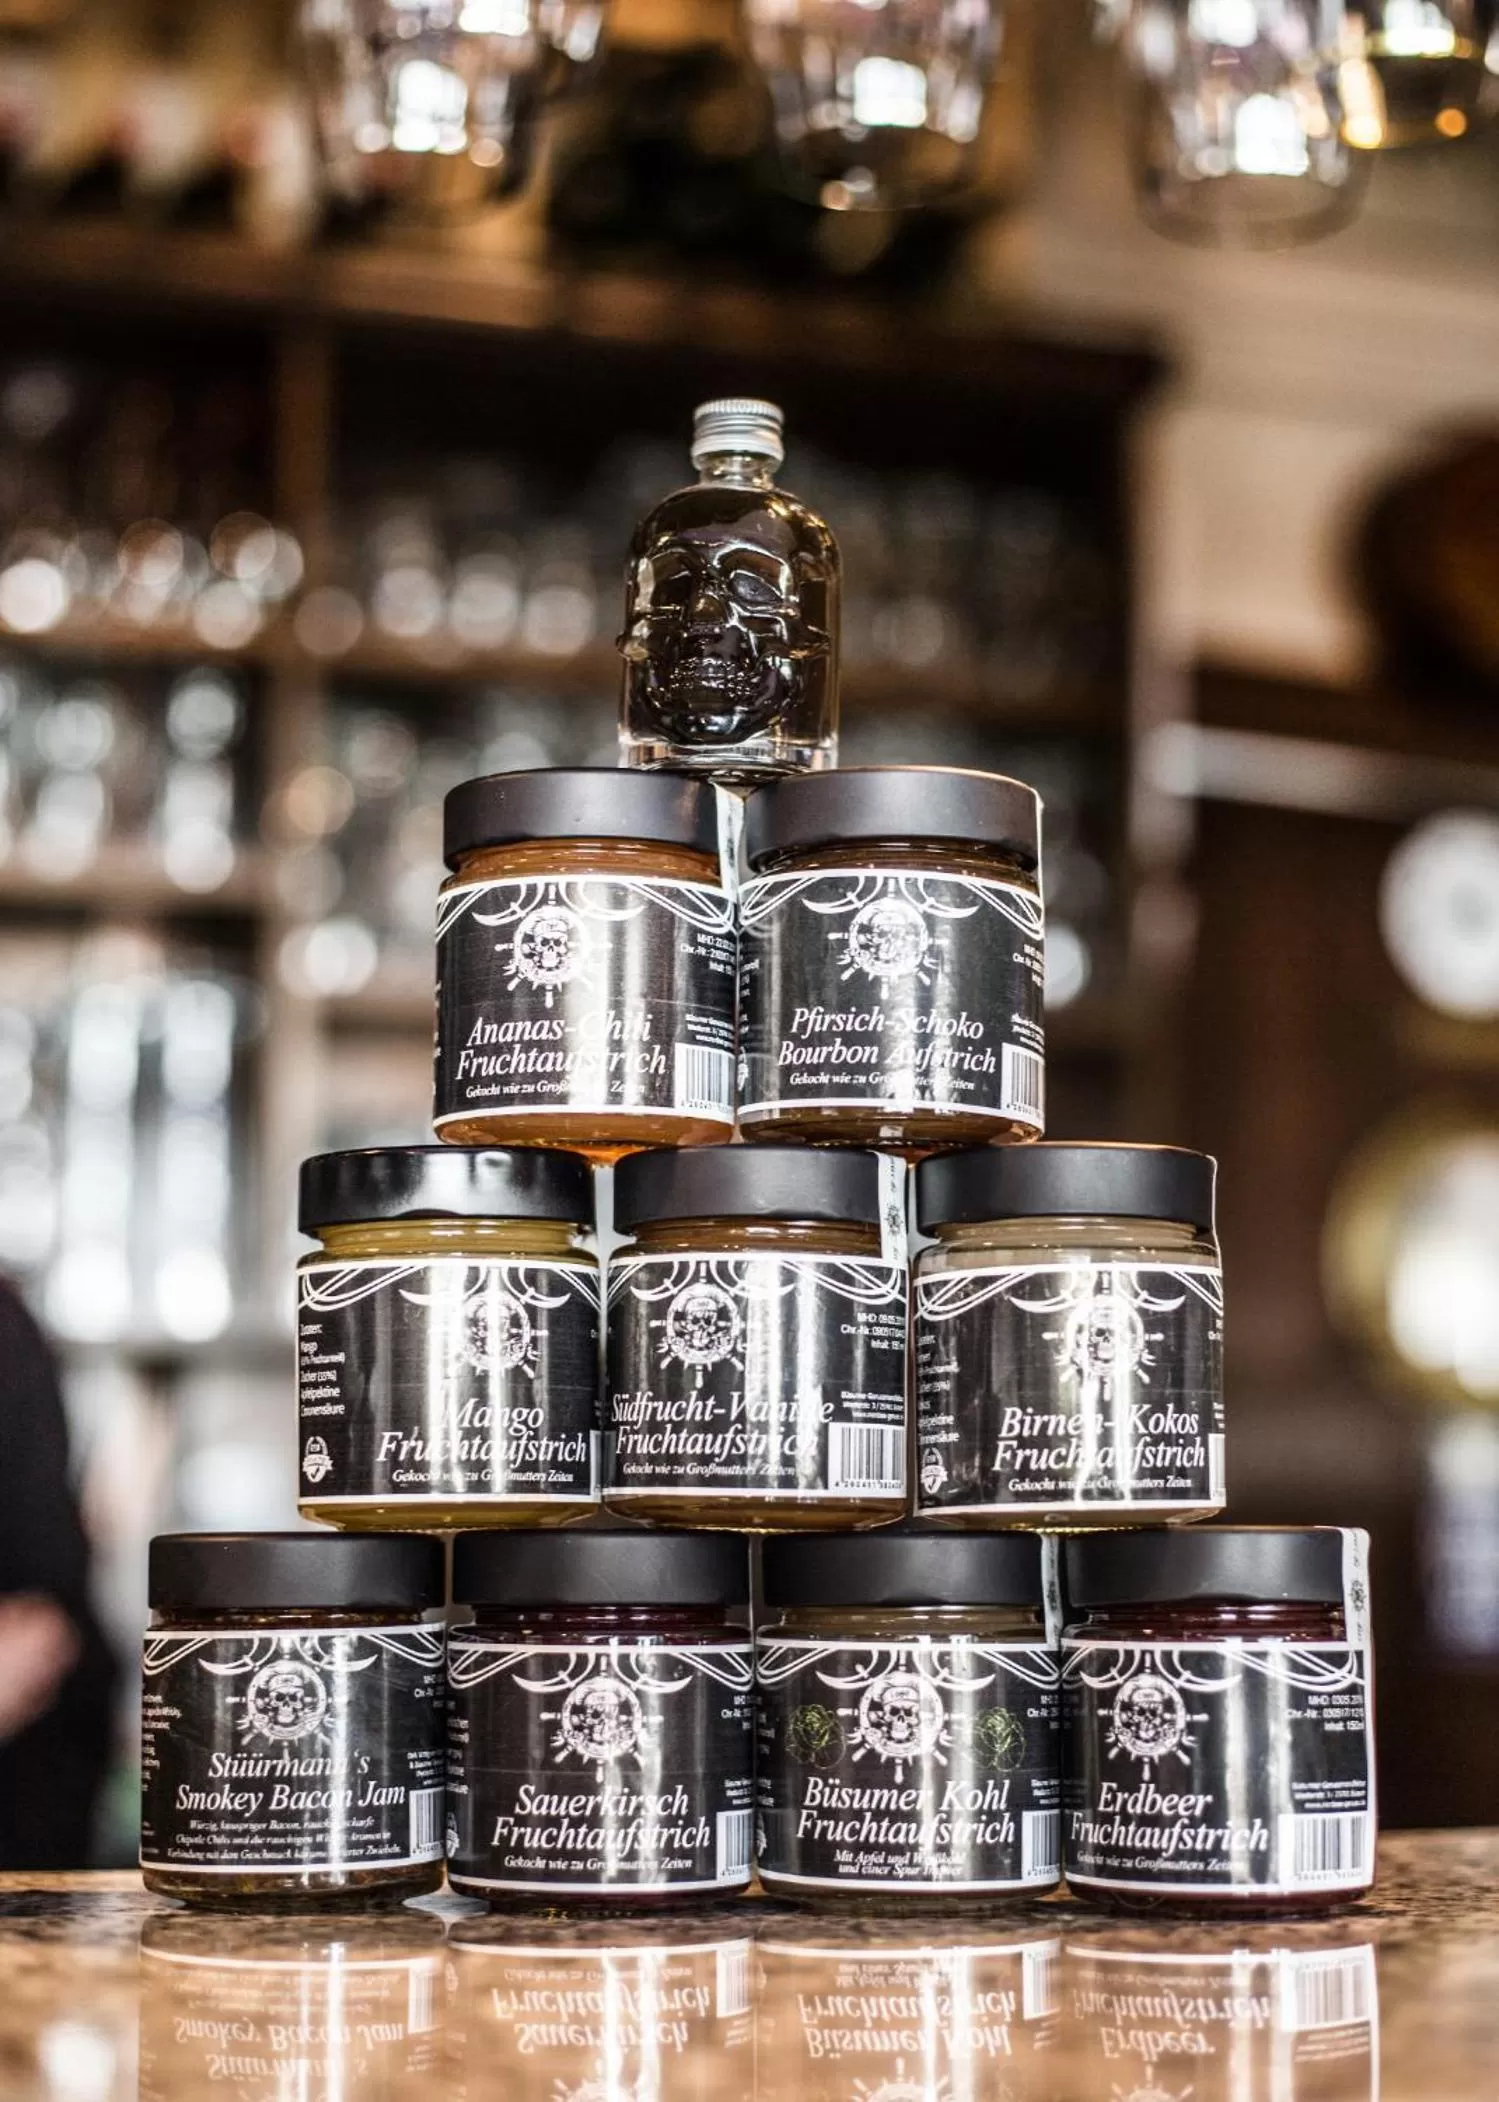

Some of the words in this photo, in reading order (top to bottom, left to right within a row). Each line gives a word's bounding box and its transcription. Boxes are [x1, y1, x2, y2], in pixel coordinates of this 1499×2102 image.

[790, 1006, 984, 1040] Pfirsich-Schoko
[778, 1040, 878, 1067] Bourbon
[885, 1044, 996, 1074] Aufstrich
[502, 1082, 521, 1095] wie
[521, 1083, 536, 1095] zu
[789, 1071, 830, 1086] Gekocht
[831, 1072, 851, 1084] wie
[853, 1074, 867, 1085] zu
[442, 1398, 545, 1437] Mango
[612, 1391, 834, 1429] Südfrucht-Vanie
[376, 1430, 586, 1468] Fruchtaufstrich
[616, 1424, 818, 1462] Fruchtaufstrich
[655, 1463, 671, 1475] wie
[672, 1465, 685, 1475] zu
[175, 1784, 264, 1817] Smokey
[268, 1784, 352, 1810] Bacon
[358, 1781, 405, 1806] Jam
[514, 1784, 689, 1817] Sauerkirsch
[803, 1776, 933, 1809] Büsumer
[939, 1779, 1011, 1811] Kohl
[1098, 1782, 1213, 1817] Erdbeer
[490, 1815, 711, 1857] Fruchtaufstrich
[796, 1808, 1016, 1848] Fruchtaufstrich
[1071, 1811, 1269, 1857] Fruchtaufstrich
[504, 1855, 546, 1869] Gekocht
[548, 1857, 568, 1869] wie
[570, 1859, 584, 1870] zu
[660, 1857, 693, 1869] Zeiten
[834, 1849, 853, 1863] Mit
